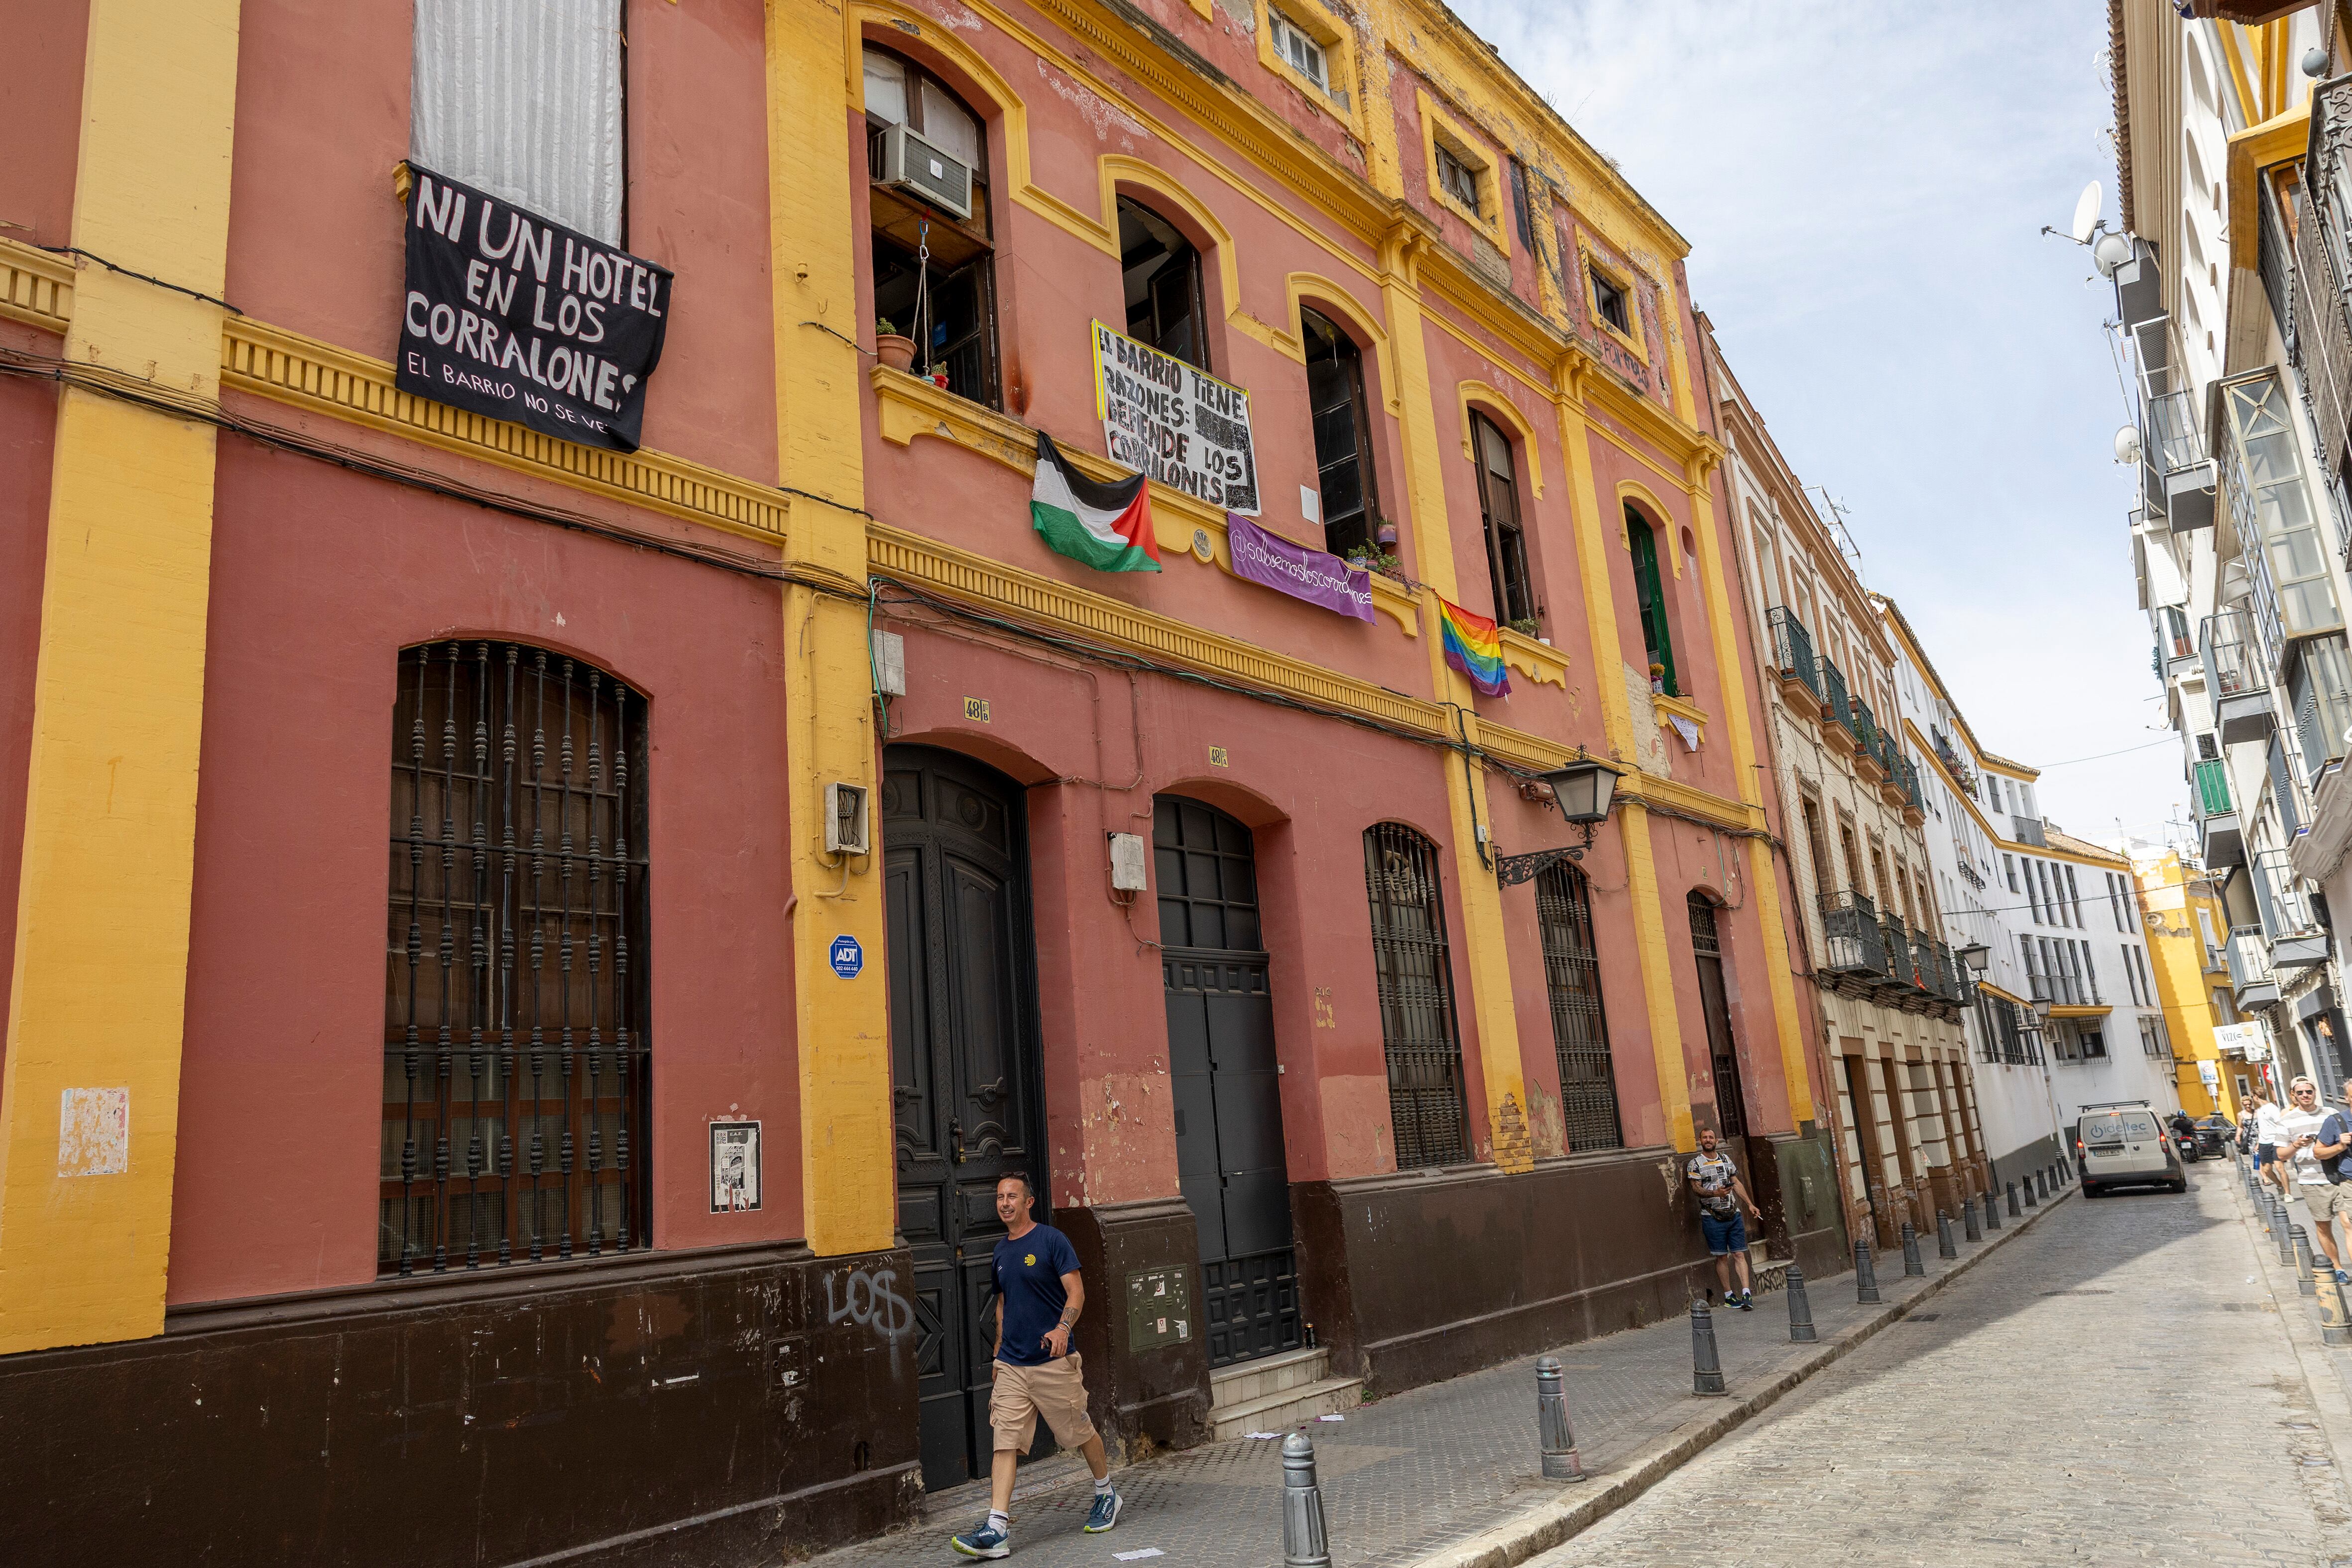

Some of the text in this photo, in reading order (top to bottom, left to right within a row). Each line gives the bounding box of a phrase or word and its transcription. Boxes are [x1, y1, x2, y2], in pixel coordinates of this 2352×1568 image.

[416, 175, 661, 317] NI UN HOTEL
[467, 259, 606, 342] EN LOS
[408, 351, 609, 434] EL BARRIO NO SE VE
[1104, 365, 1190, 428] RAZONES:
[1107, 393, 1189, 464] DEFIENDE
[1109, 430, 1242, 505] CORRALONES LOS
[966, 700, 980, 718] 48
[1211, 749, 1220, 764] 48
[836, 948, 857, 962] ADT
